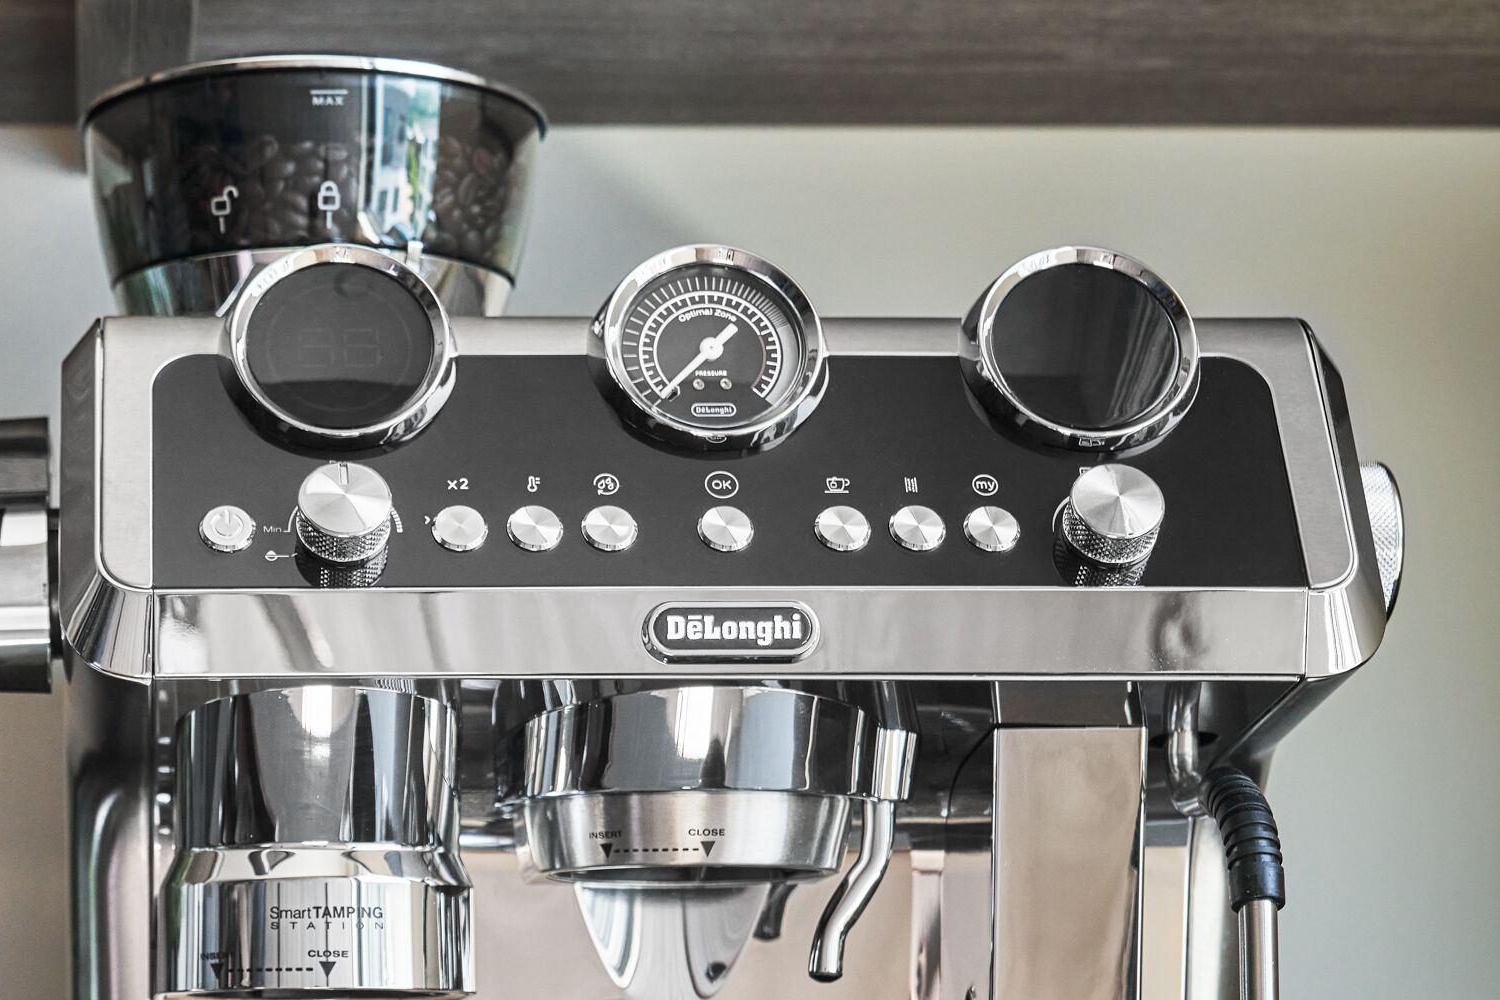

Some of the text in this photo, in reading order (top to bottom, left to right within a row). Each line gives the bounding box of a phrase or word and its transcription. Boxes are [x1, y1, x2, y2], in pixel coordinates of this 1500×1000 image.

[311, 95, 345, 106] MAX
[678, 308, 738, 323] Optimal Zone
[695, 369, 728, 377] PRESSURE
[711, 479, 732, 490] OK
[975, 480, 996, 492] my
[263, 525, 282, 534] Min
[588, 830, 623, 840] INSERT
[688, 827, 726, 837] CLOSE
[307, 950, 349, 958] CLOSE
